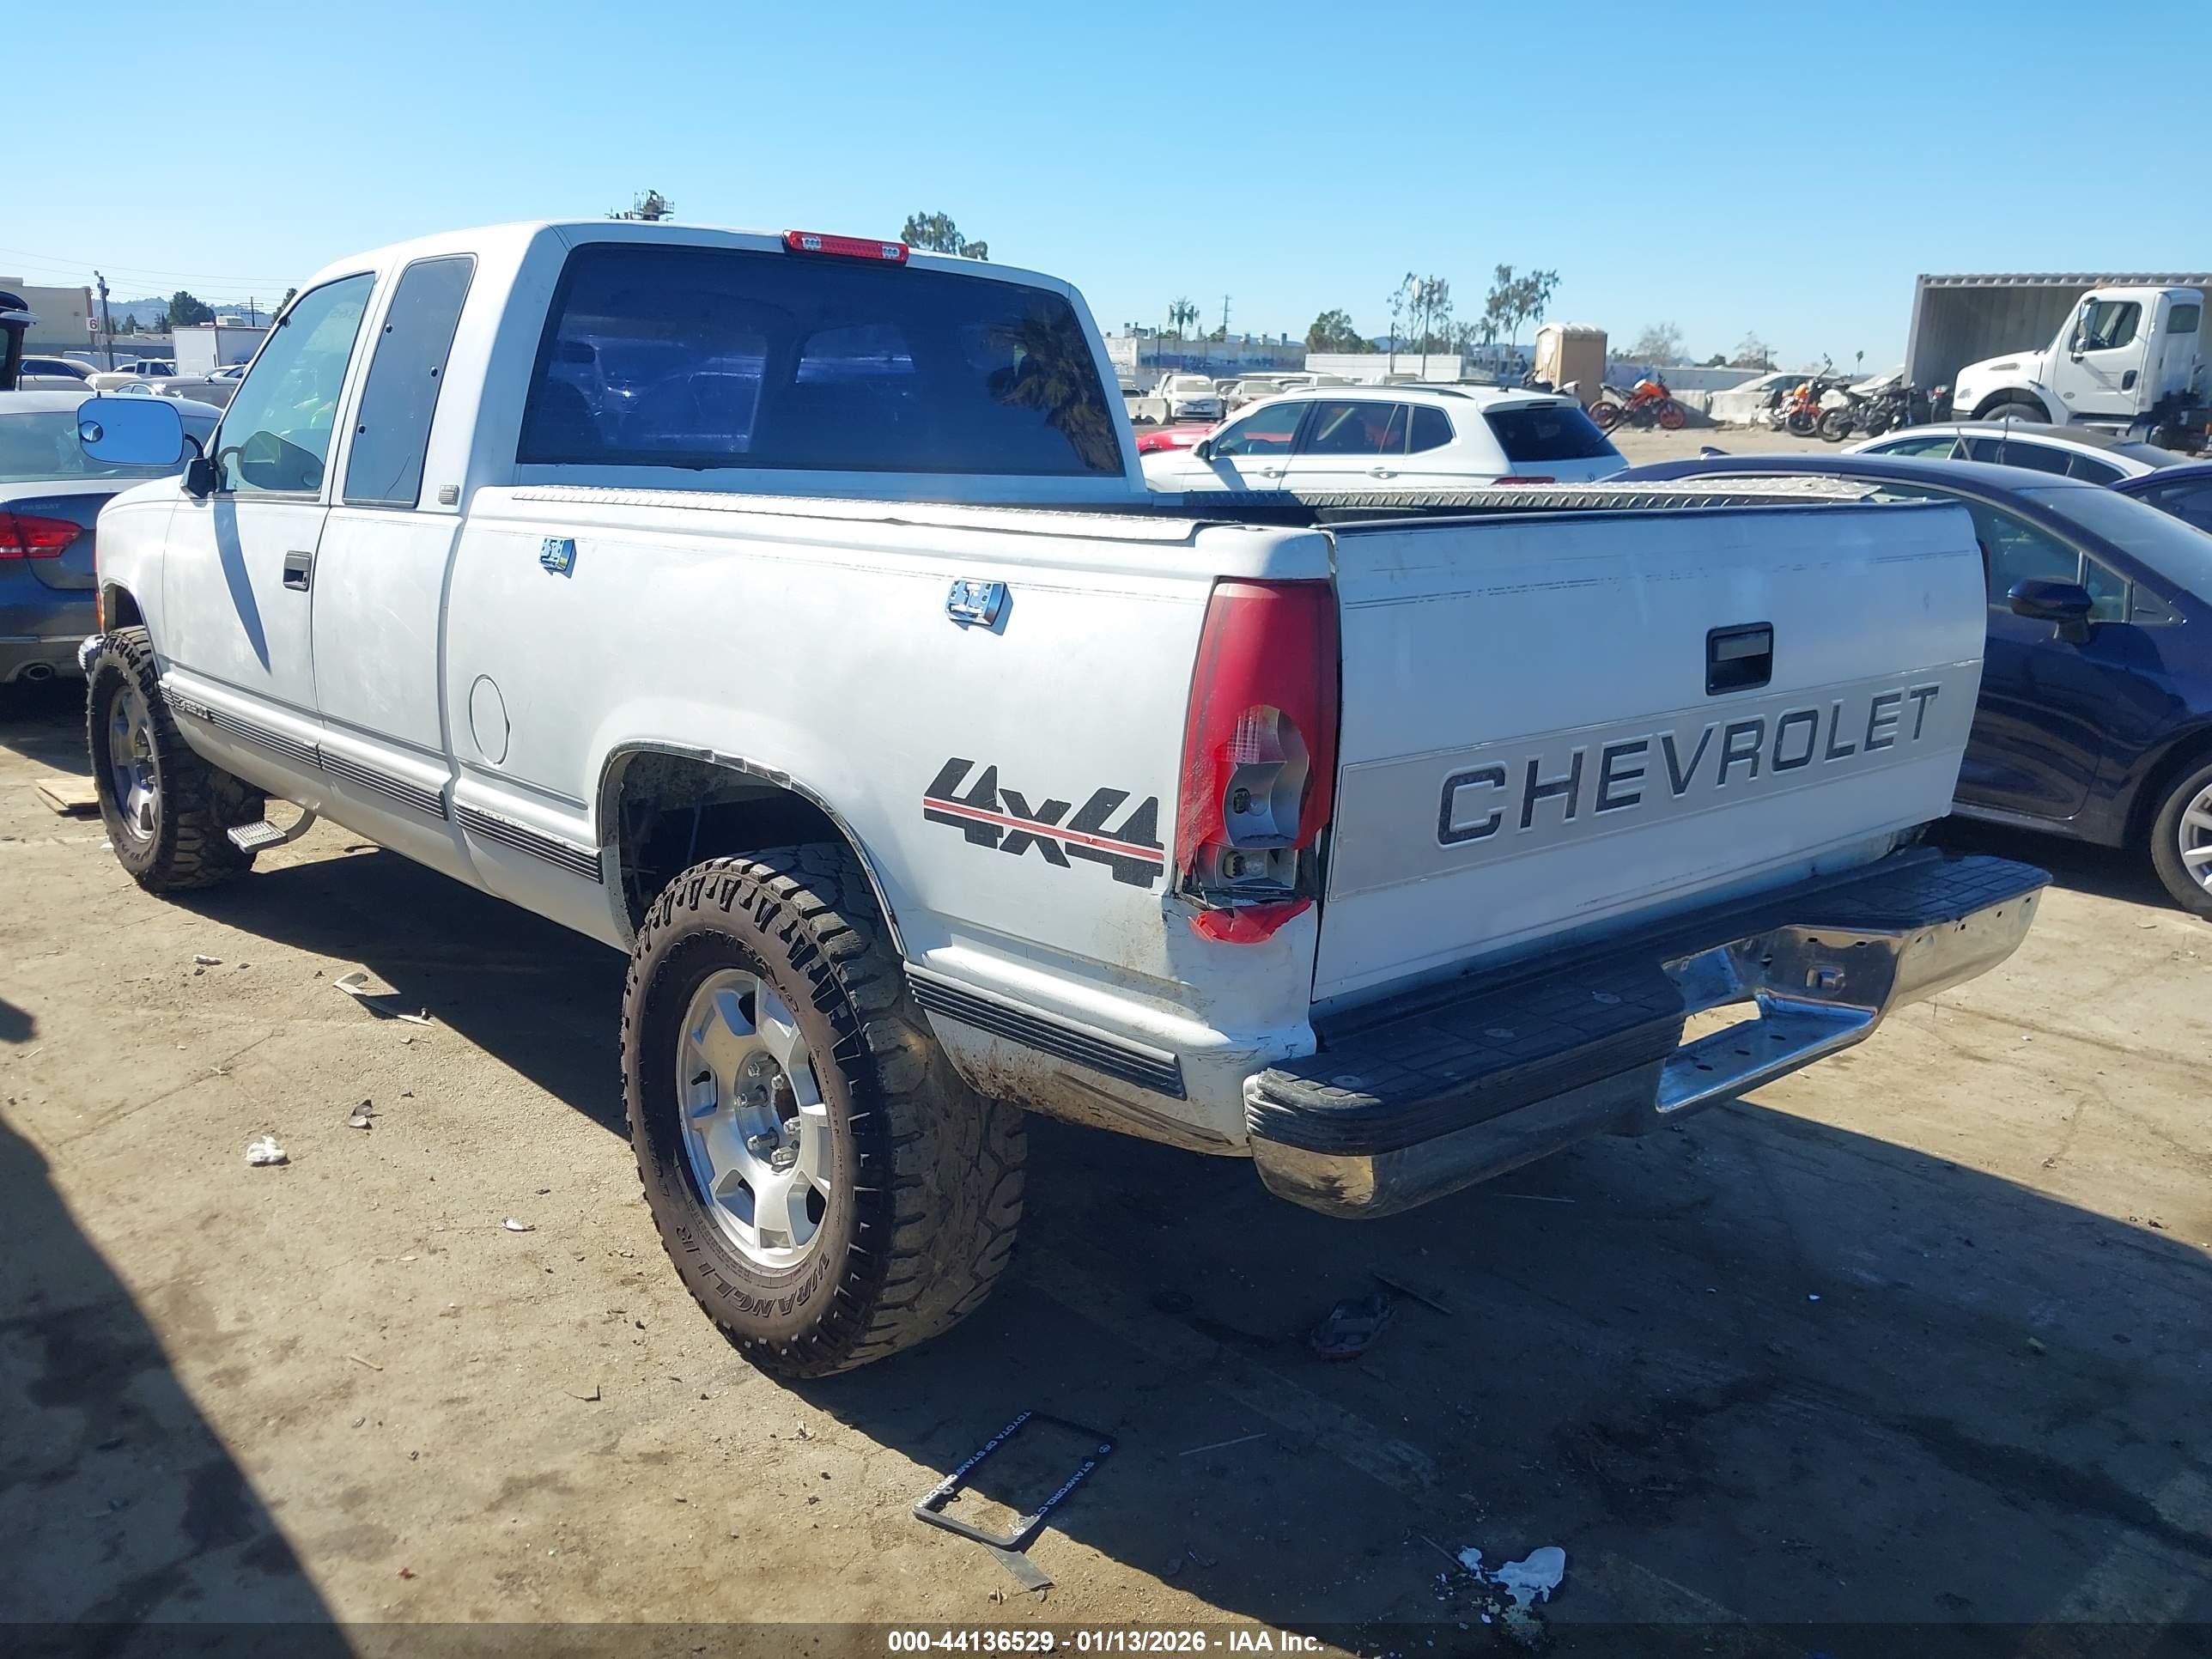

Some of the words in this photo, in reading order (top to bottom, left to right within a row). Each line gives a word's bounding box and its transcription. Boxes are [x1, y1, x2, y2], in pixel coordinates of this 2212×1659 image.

[89, 319, 97, 330] 6
[1437, 683, 1942, 848] CHEVROLET
[996, 1410, 1031, 1440] TOYOTA
[985, 1440, 998, 1451] OF
